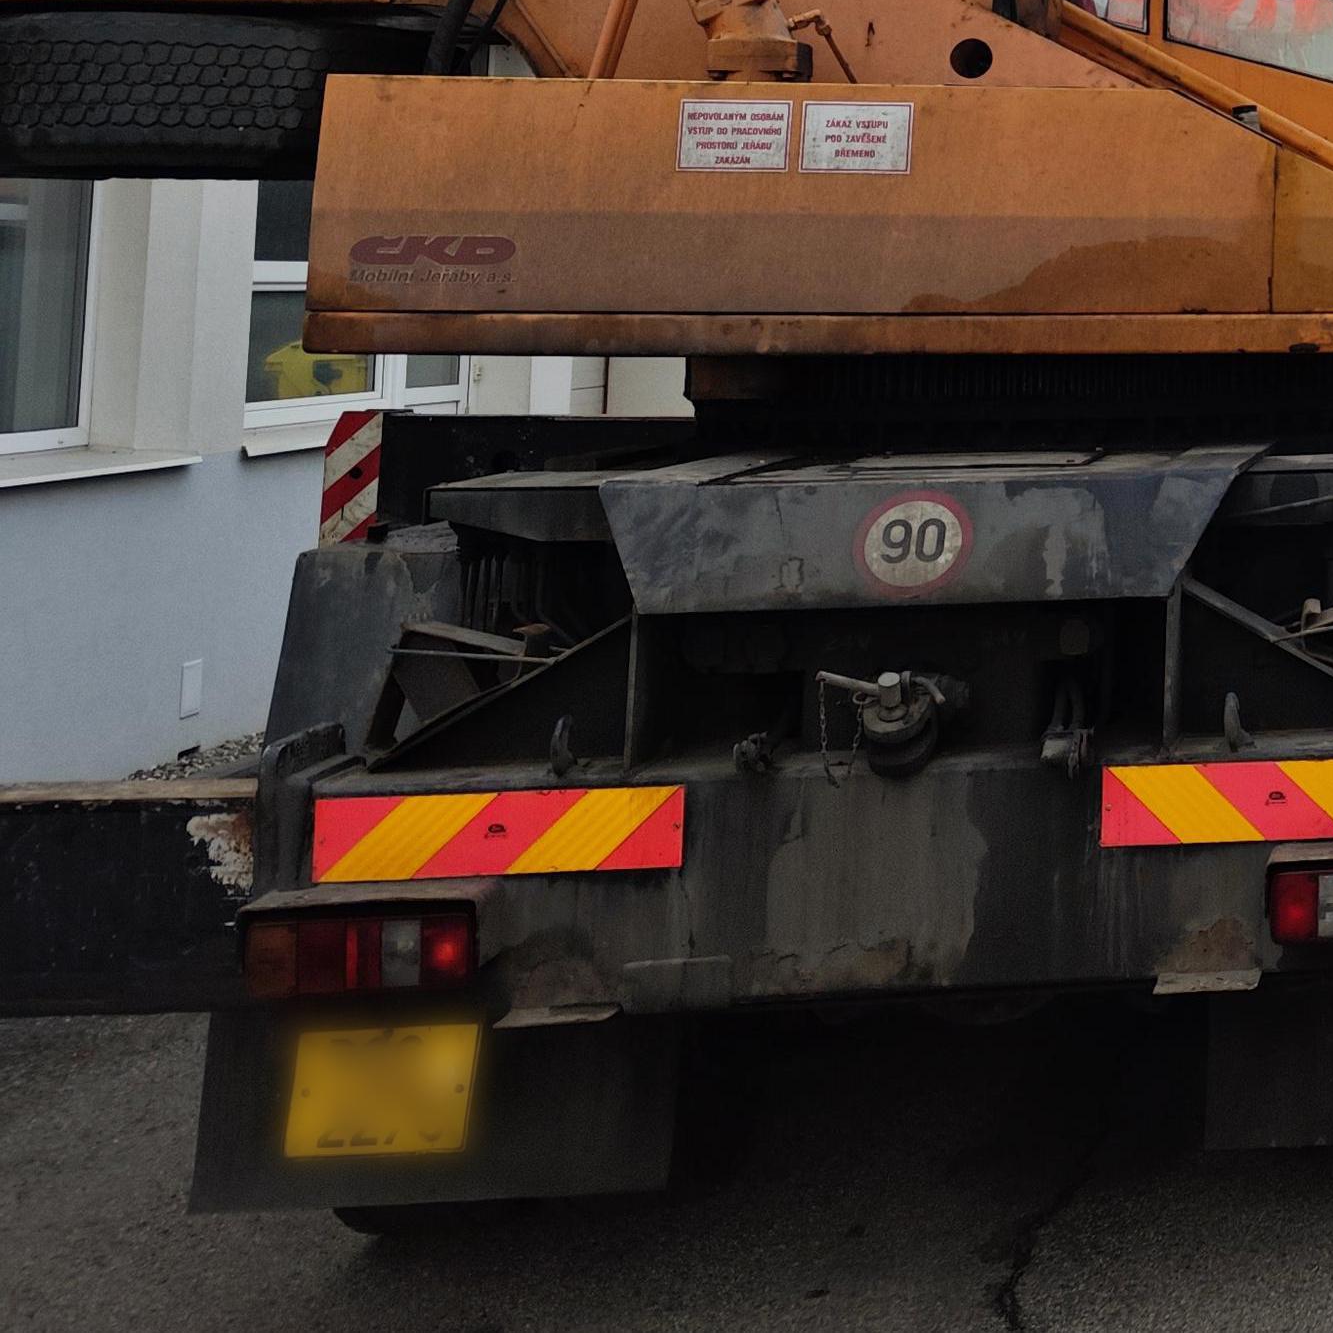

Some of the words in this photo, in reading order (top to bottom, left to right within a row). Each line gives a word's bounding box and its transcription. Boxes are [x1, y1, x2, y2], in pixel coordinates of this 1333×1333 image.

[687, 110, 747, 121] NEPOVOLANÝM
[751, 110, 785, 121] OSOBÁM
[825, 117, 852, 128] ZÁKAZ
[856, 119, 889, 129] VSTUPU
[687, 126, 714, 135] VSTUP
[717, 127, 728, 135] DO
[731, 124, 782, 136] PRACOVNÍHO
[825, 134, 842, 143] POD
[846, 132, 887, 143] ZAVĚŠENÉ
[695, 141, 738, 150] PROSTORU
[741, 140, 773, 150] JEŘÁBU
[834, 147, 876, 158] BŘEMENO
[350, 269, 414, 284] Mobilní
[486, 272, 516, 283] a.s.
[880, 517, 947, 564] 90
